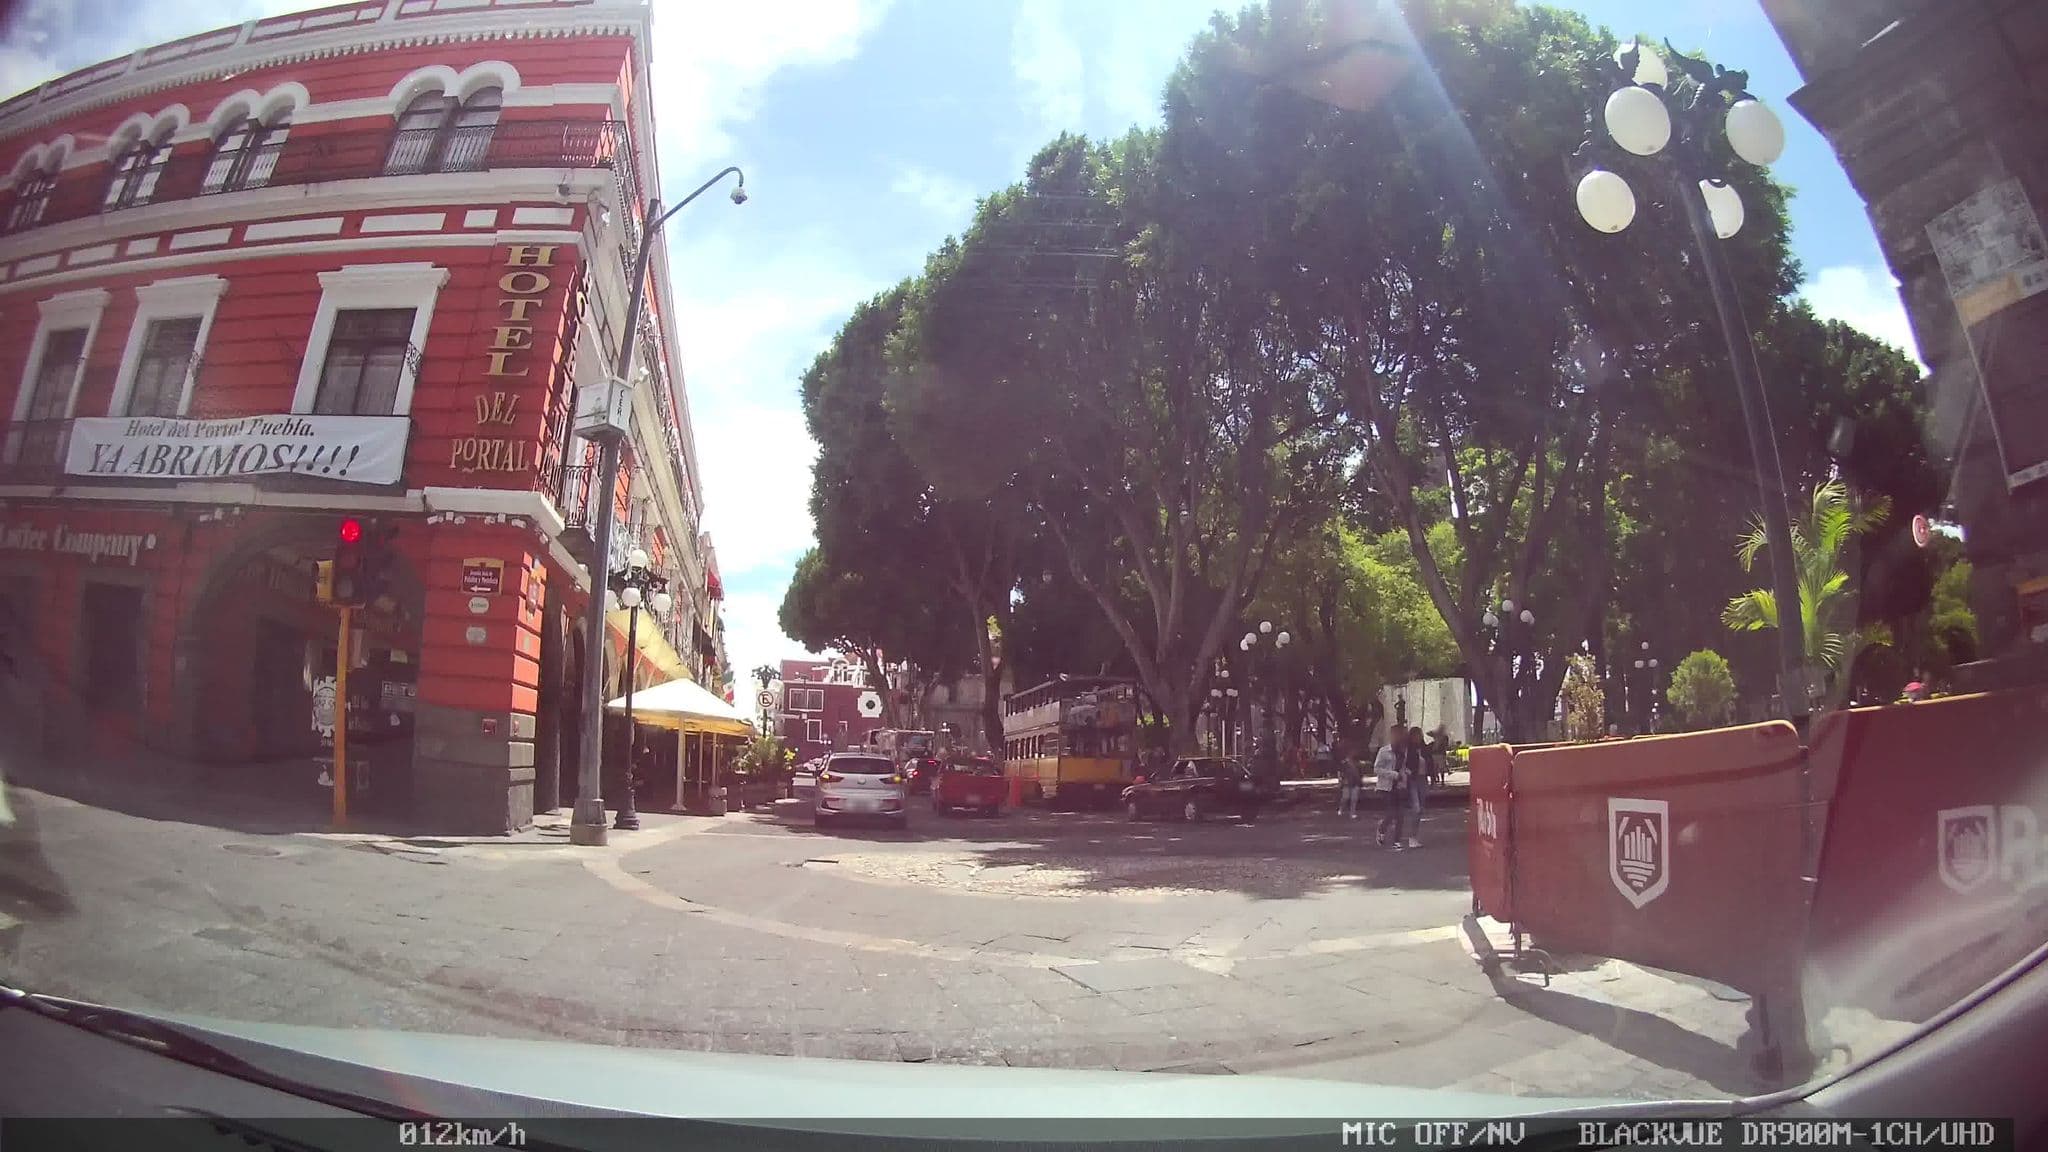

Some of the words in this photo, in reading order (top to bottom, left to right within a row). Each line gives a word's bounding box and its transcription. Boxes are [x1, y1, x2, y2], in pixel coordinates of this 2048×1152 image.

[482, 245, 560, 376] HOTEL
[475, 392, 521, 425] DEL
[124, 419, 167, 437] Hotel
[167, 420, 190, 438] del
[193, 420, 245, 439] Portal
[248, 417, 315, 437] Puebla.
[88, 443, 124, 473] YA
[450, 437, 529, 473] PORTAL
